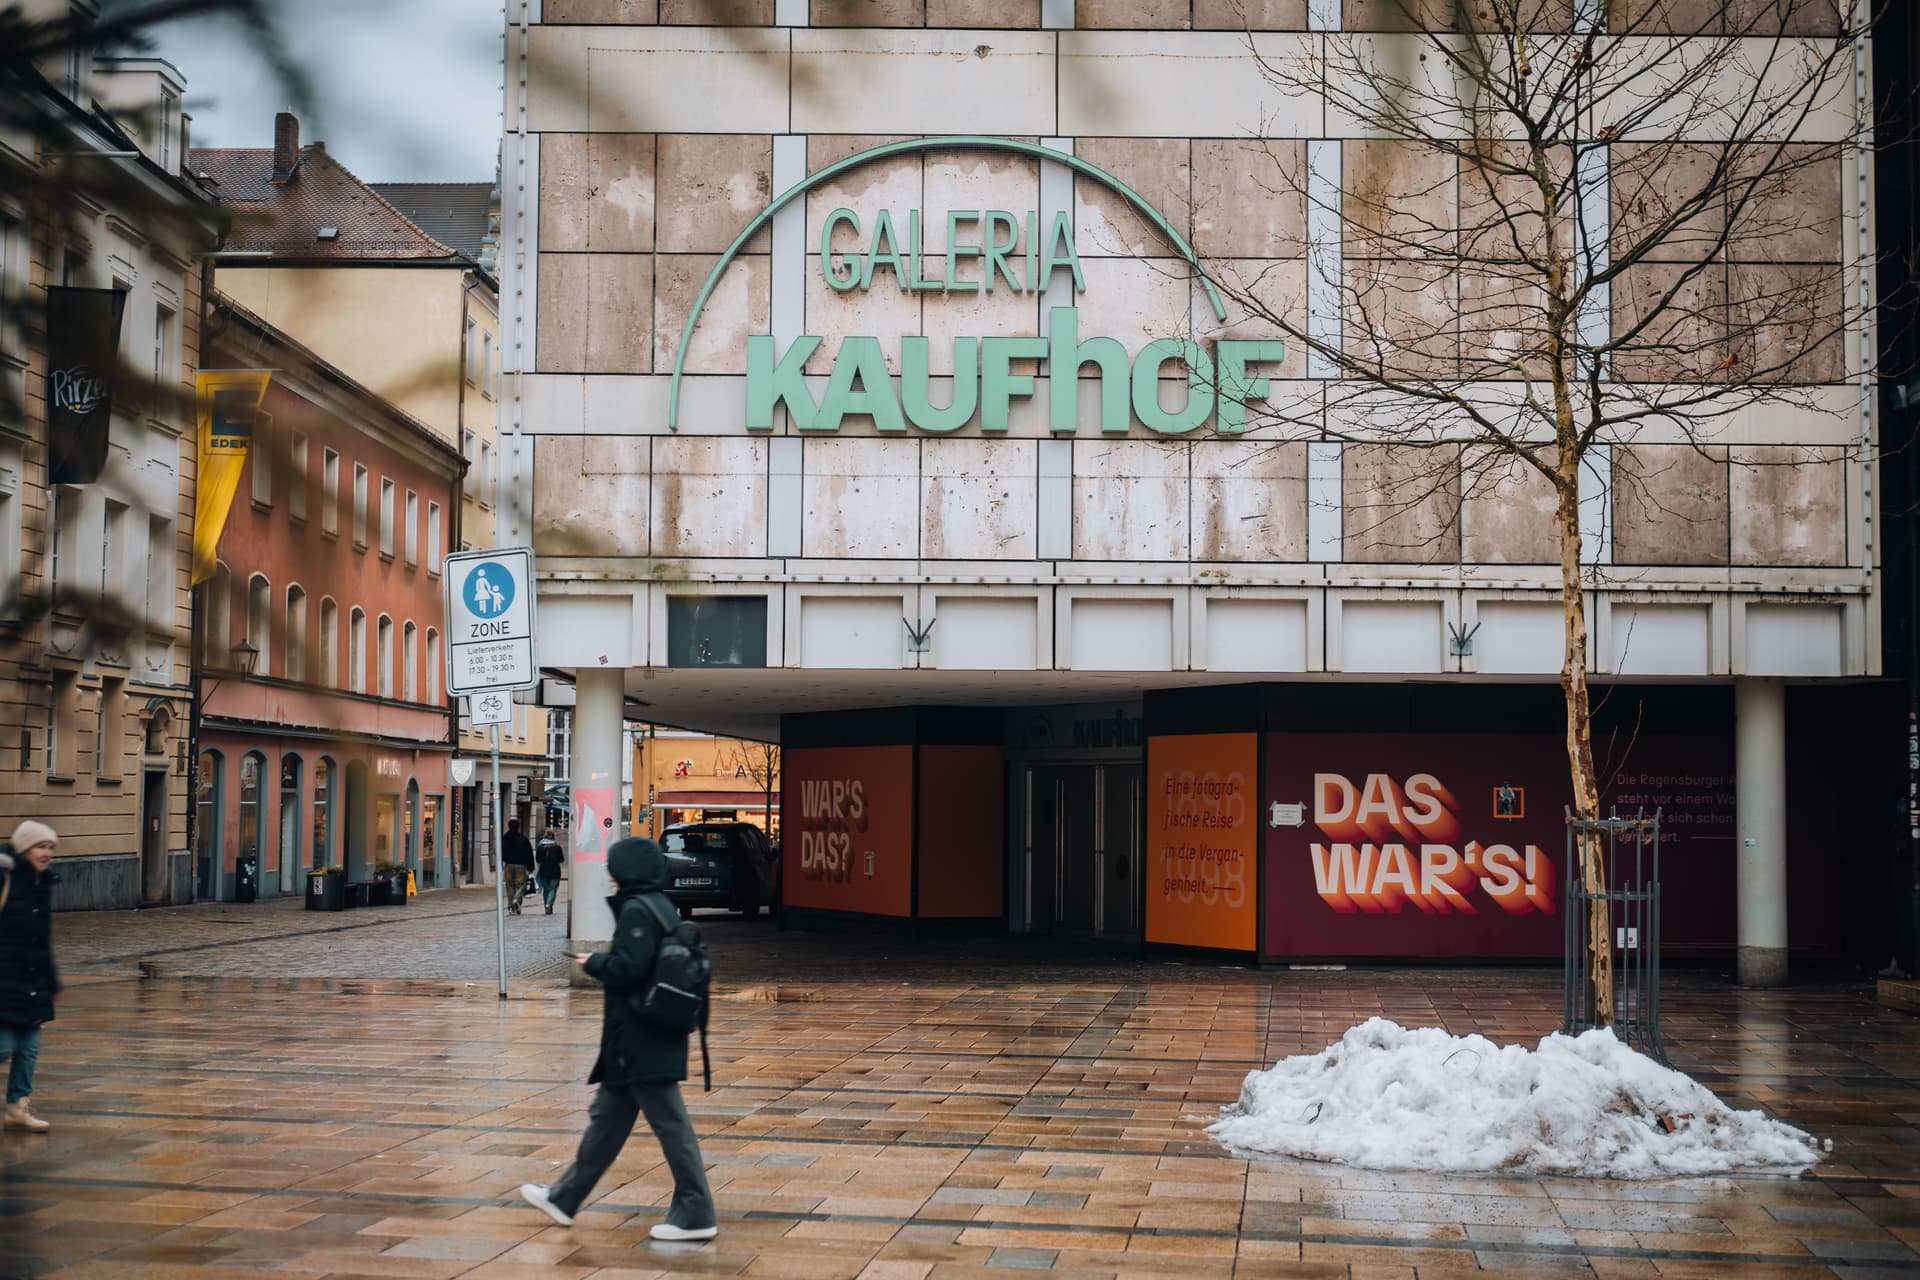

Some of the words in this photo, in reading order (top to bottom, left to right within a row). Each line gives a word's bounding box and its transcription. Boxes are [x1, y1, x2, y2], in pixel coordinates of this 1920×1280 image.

[821, 207, 1086, 294] GALERIA
[471, 621, 510, 638] ZONE
[467, 644, 515, 655] Lieferverkehr
[485, 713, 498, 721] frei
[1165, 778, 1189, 795] Eine
[1191, 777, 1239, 801] fotogra-
[1617, 775, 1636, 785] Die
[1641, 775, 1725, 788] Regensburger
[1314, 773, 1442, 825] DAS
[1617, 793, 1649, 804] steht
[1653, 796, 1673, 805] vor
[1675, 793, 1713, 805] einem
[1163, 810, 1199, 832] fische
[1202, 811, 1234, 829] Reise
[1668, 811, 1693, 824] sich
[1697, 811, 1733, 824] schon
[802, 831, 850, 871] DAS?
[1164, 842, 1175, 860] in
[1178, 842, 1196, 860] die
[1199, 843, 1245, 866] Vergan-
[1163, 876, 1209, 896] genheit.
